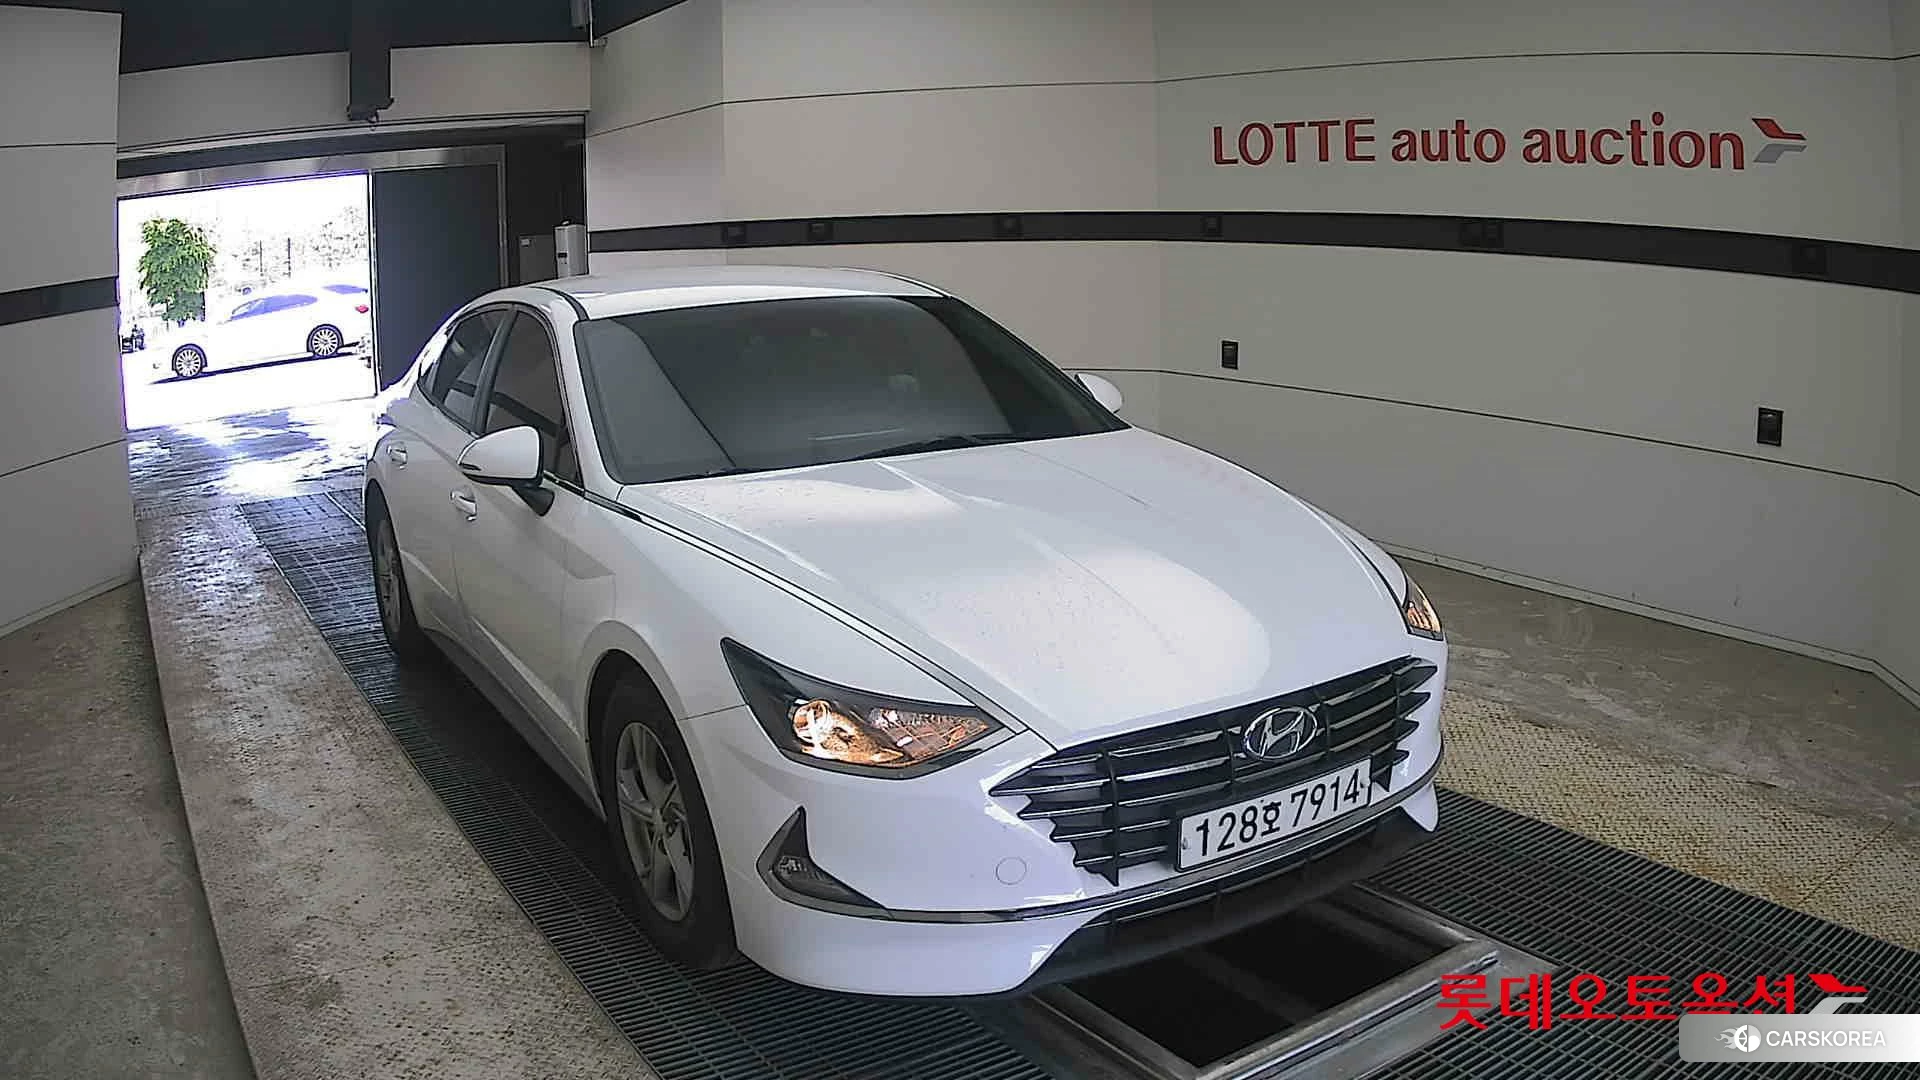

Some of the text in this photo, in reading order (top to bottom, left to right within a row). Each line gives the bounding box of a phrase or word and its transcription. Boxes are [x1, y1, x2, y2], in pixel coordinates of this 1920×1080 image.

[1213, 111, 1745, 170] LOTTE auto auction
[1196, 768, 1361, 857] 128호 7914
